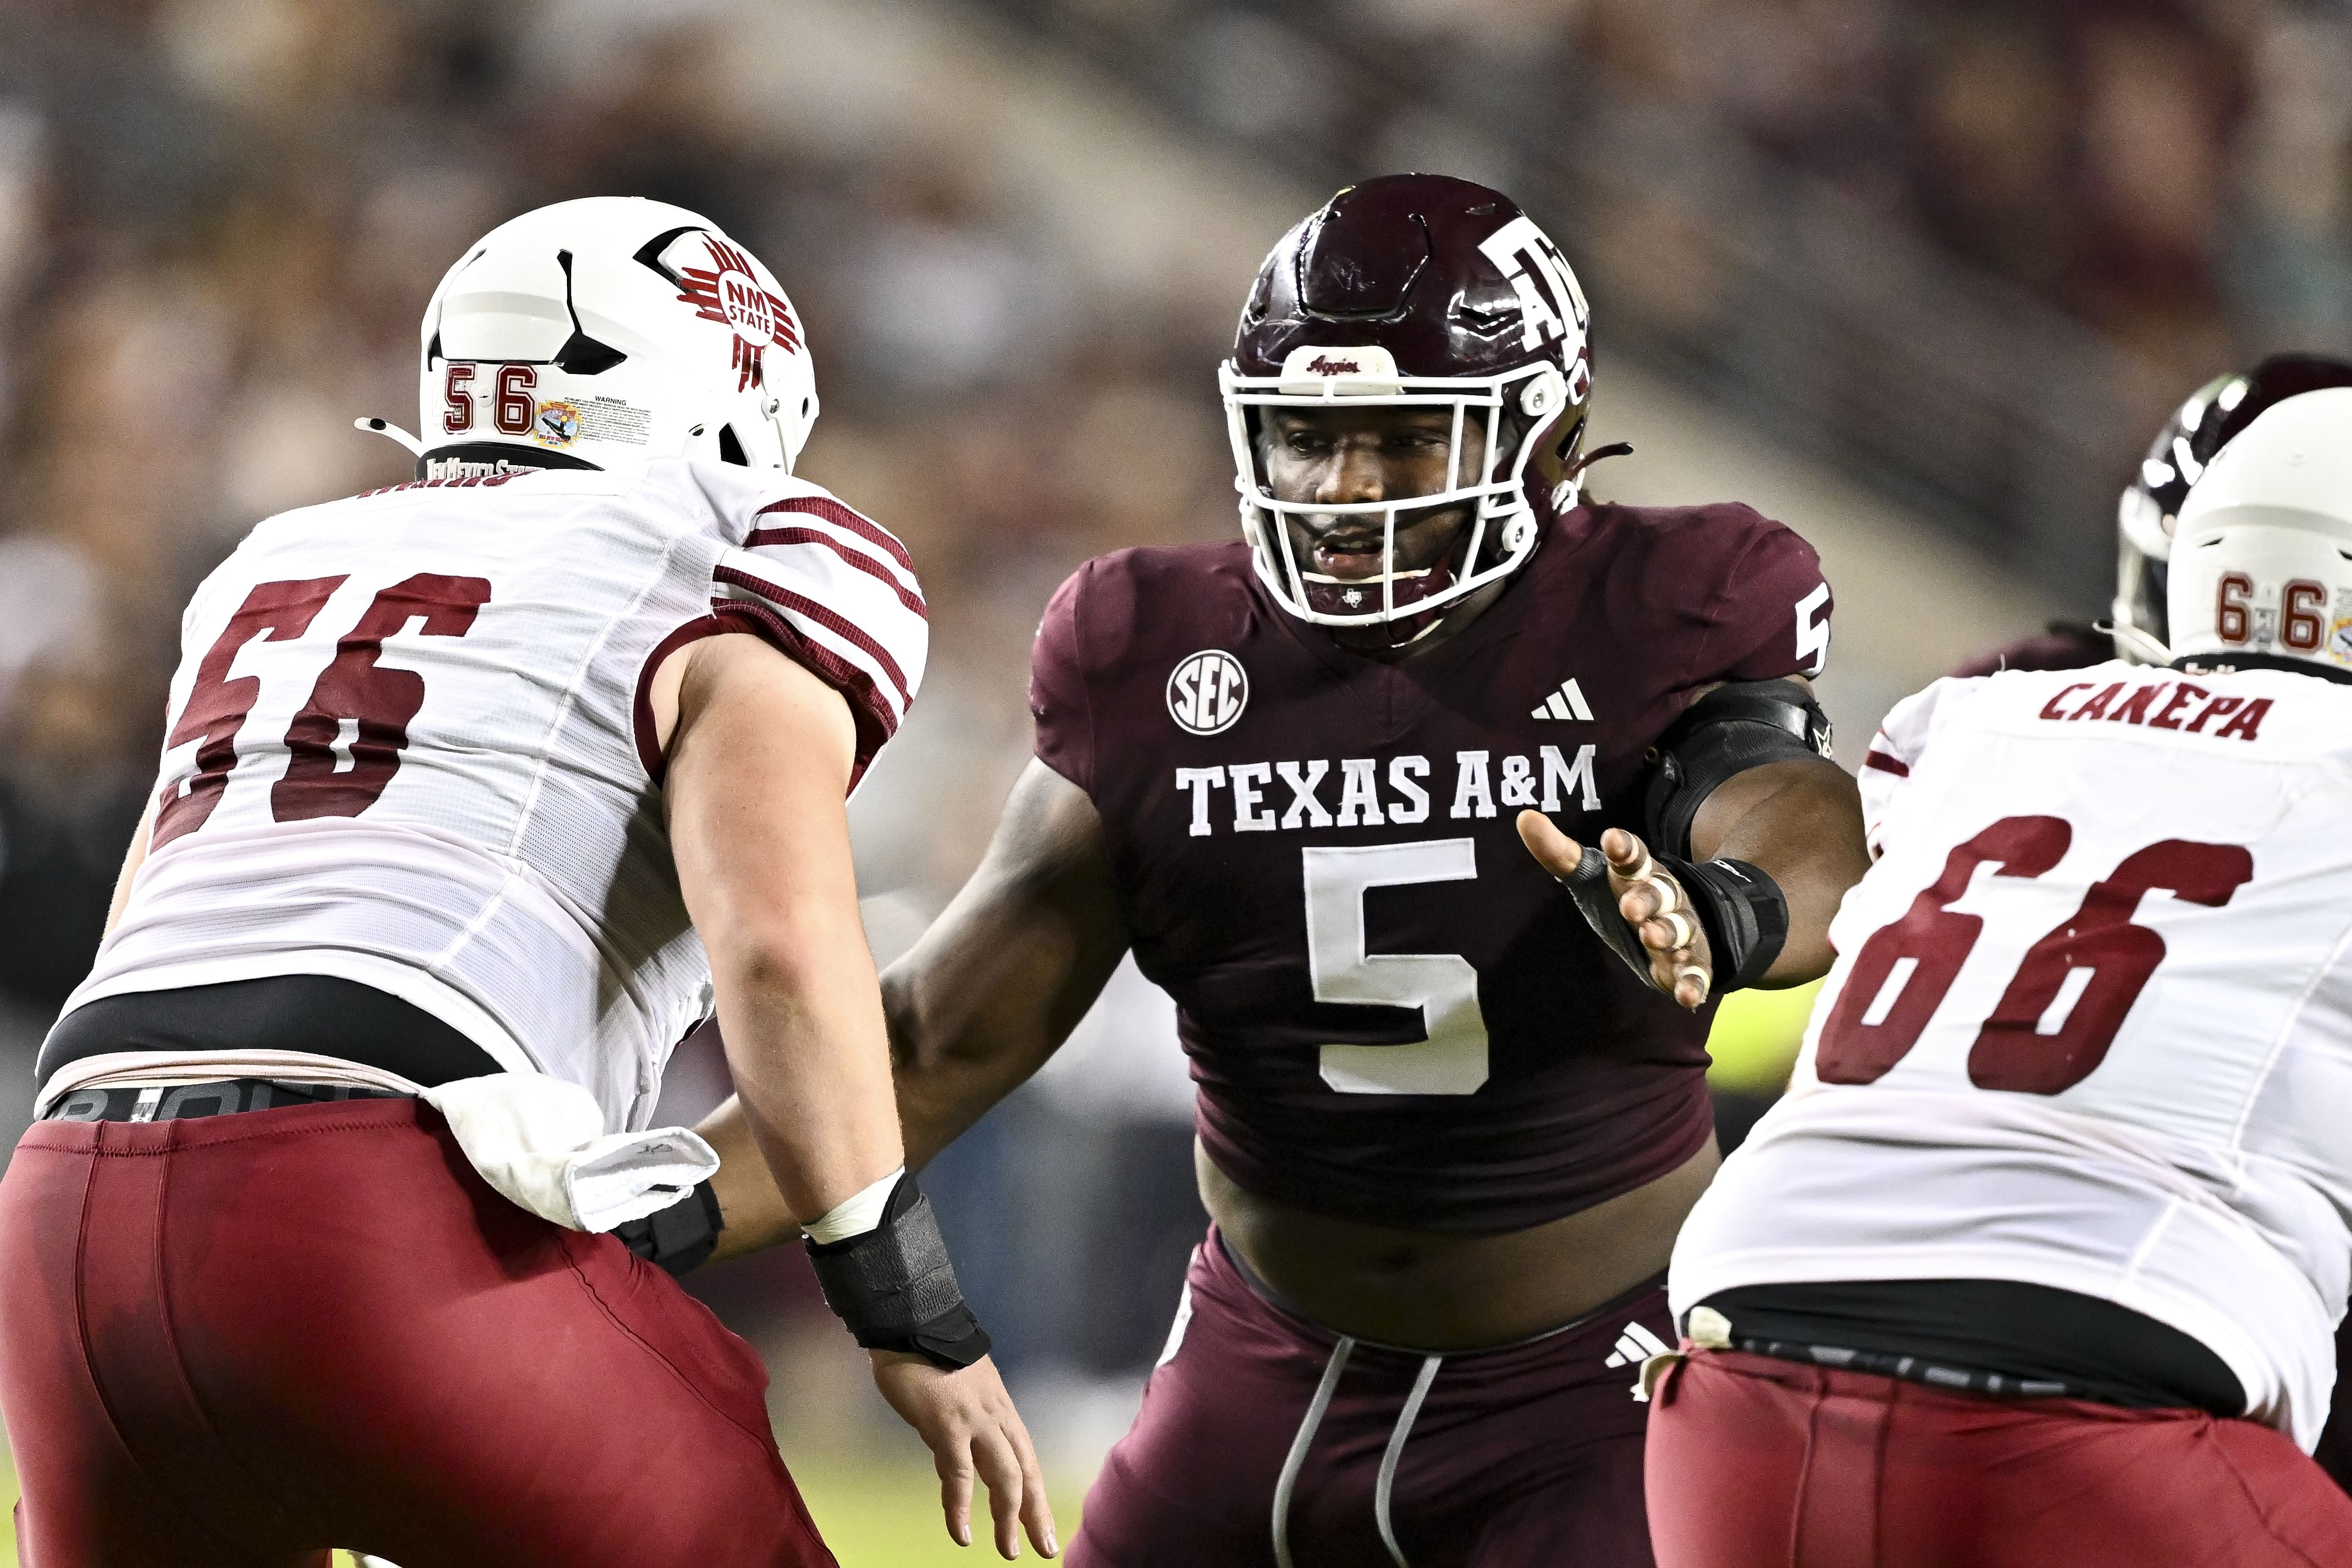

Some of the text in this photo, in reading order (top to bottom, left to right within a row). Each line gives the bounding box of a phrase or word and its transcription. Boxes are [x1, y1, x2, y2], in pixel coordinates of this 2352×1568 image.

[726, 280, 768, 316] NM
[729, 305, 770, 335] STATE
[444, 362, 537, 436] 56
[595, 395, 626, 406] WARNING
[1306, 355, 1361, 377] Aggies
[1795, 582, 1830, 675] 5
[2216, 572, 2327, 654] 66
[150, 572, 492, 856] 56
[1174, 656, 1241, 728] SEC
[2039, 681, 2274, 741] CANEPA
[1176, 744, 1602, 836] TEXAS A&M
[1302, 838, 1490, 1096] 5
[1816, 815, 2253, 1096] 66
